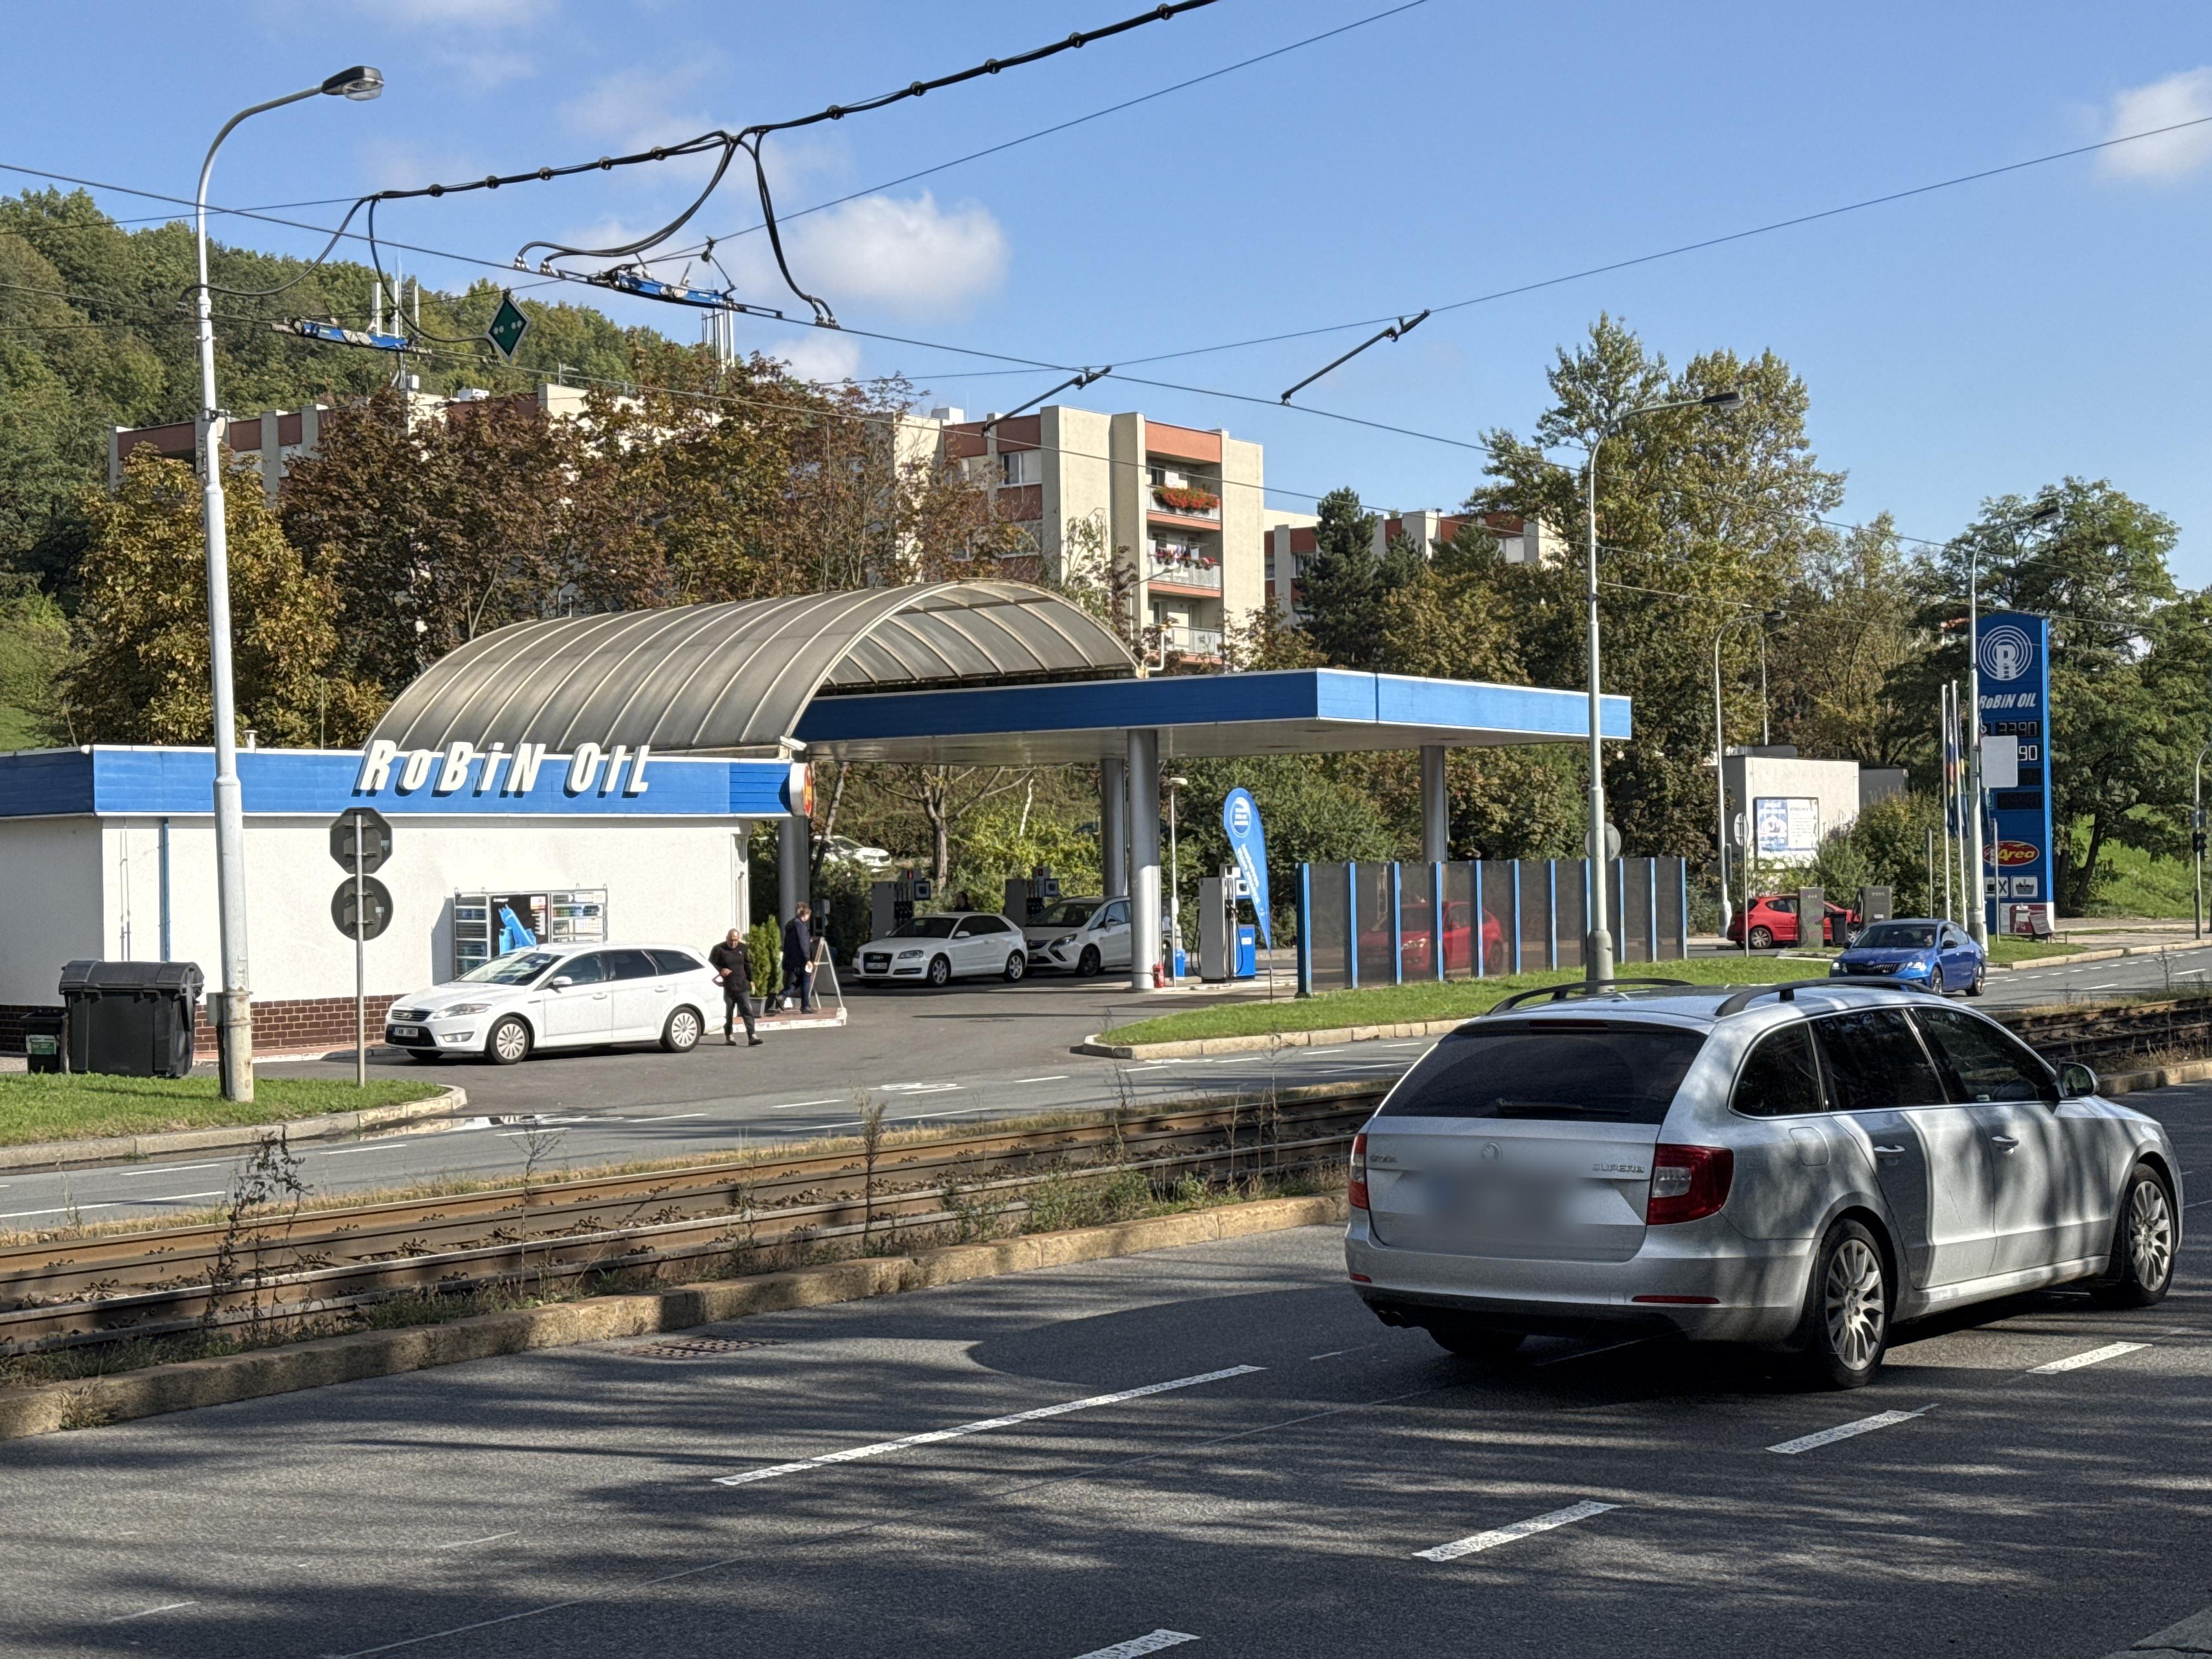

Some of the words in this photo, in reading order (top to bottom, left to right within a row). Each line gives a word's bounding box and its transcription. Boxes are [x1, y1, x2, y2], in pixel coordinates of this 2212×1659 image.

[2017, 693, 2036, 708] OIL
[570, 743, 650, 792] OIL
[1593, 1163, 1645, 1173] SUPERB
